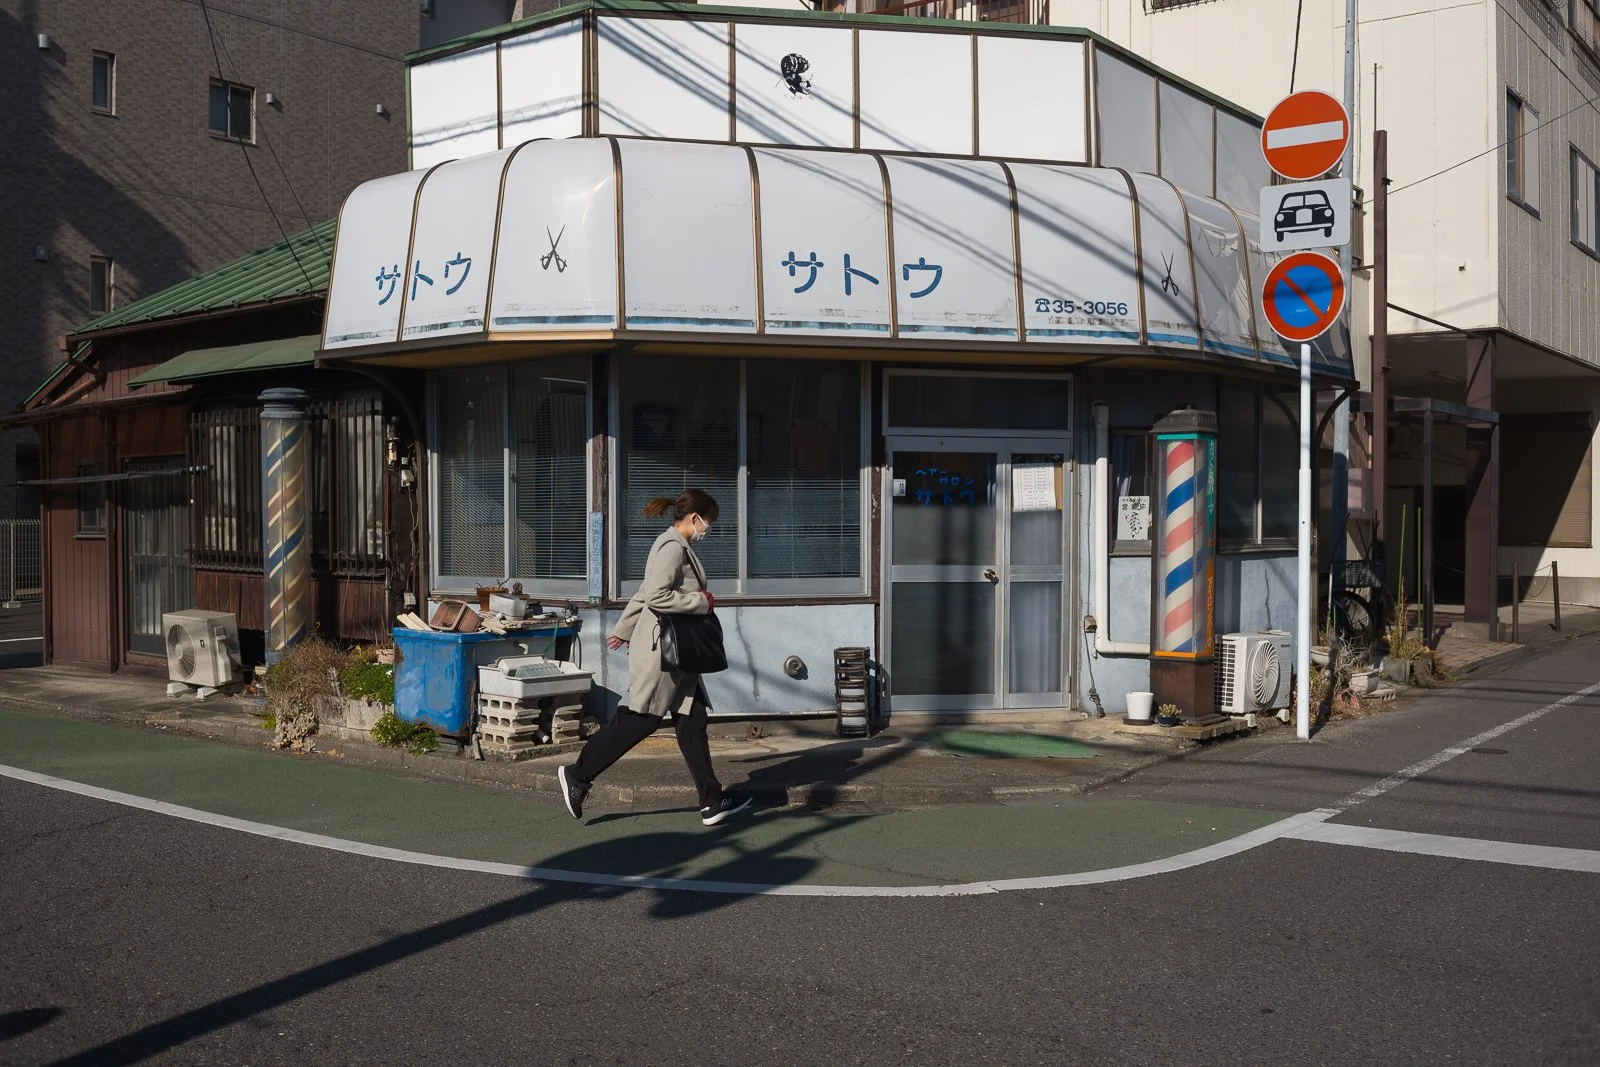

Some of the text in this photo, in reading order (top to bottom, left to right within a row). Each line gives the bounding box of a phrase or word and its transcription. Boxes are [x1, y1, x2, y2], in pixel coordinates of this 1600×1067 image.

[376, 252, 471, 305] サトウ
[782, 251, 942, 298] サトウ
[1053, 300, 1128, 315] 35-3056
